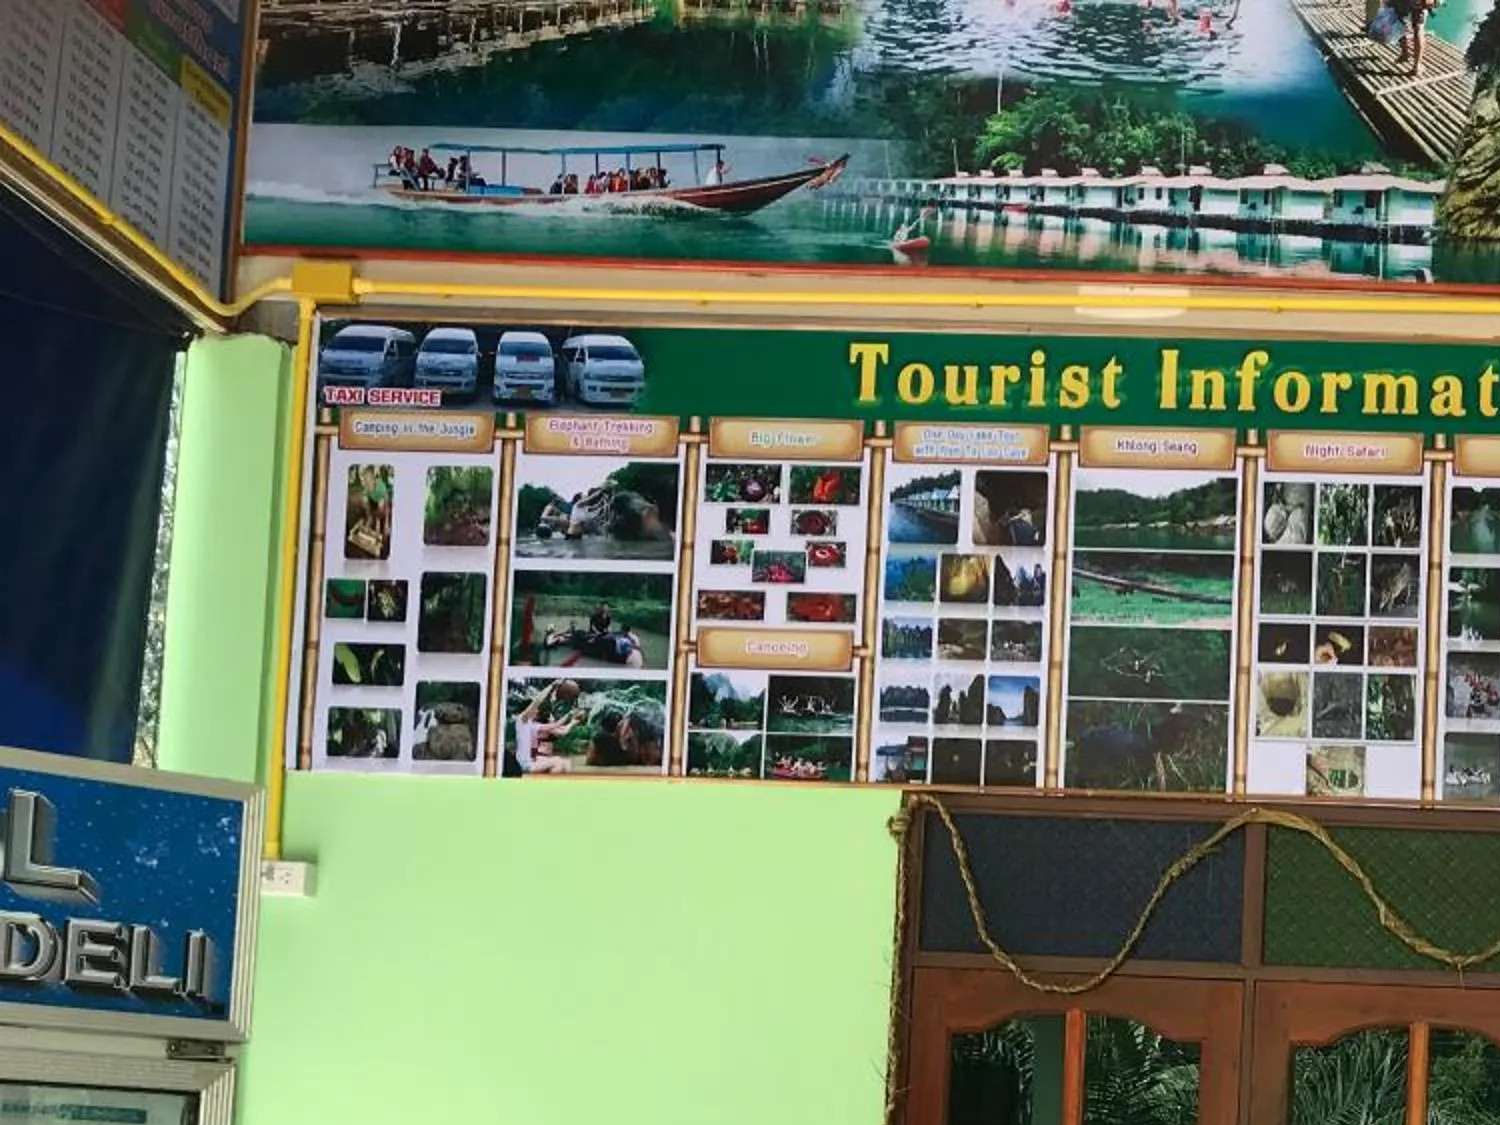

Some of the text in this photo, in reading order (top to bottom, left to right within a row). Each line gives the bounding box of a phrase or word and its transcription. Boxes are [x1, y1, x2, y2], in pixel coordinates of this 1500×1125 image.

[849, 343, 1124, 409] Tourist
[324, 387, 441, 406] TAXI SERVICE
[355, 421, 397, 435] Camping
[1305, 443, 1341, 459] Night
[3, 789, 86, 889] L
